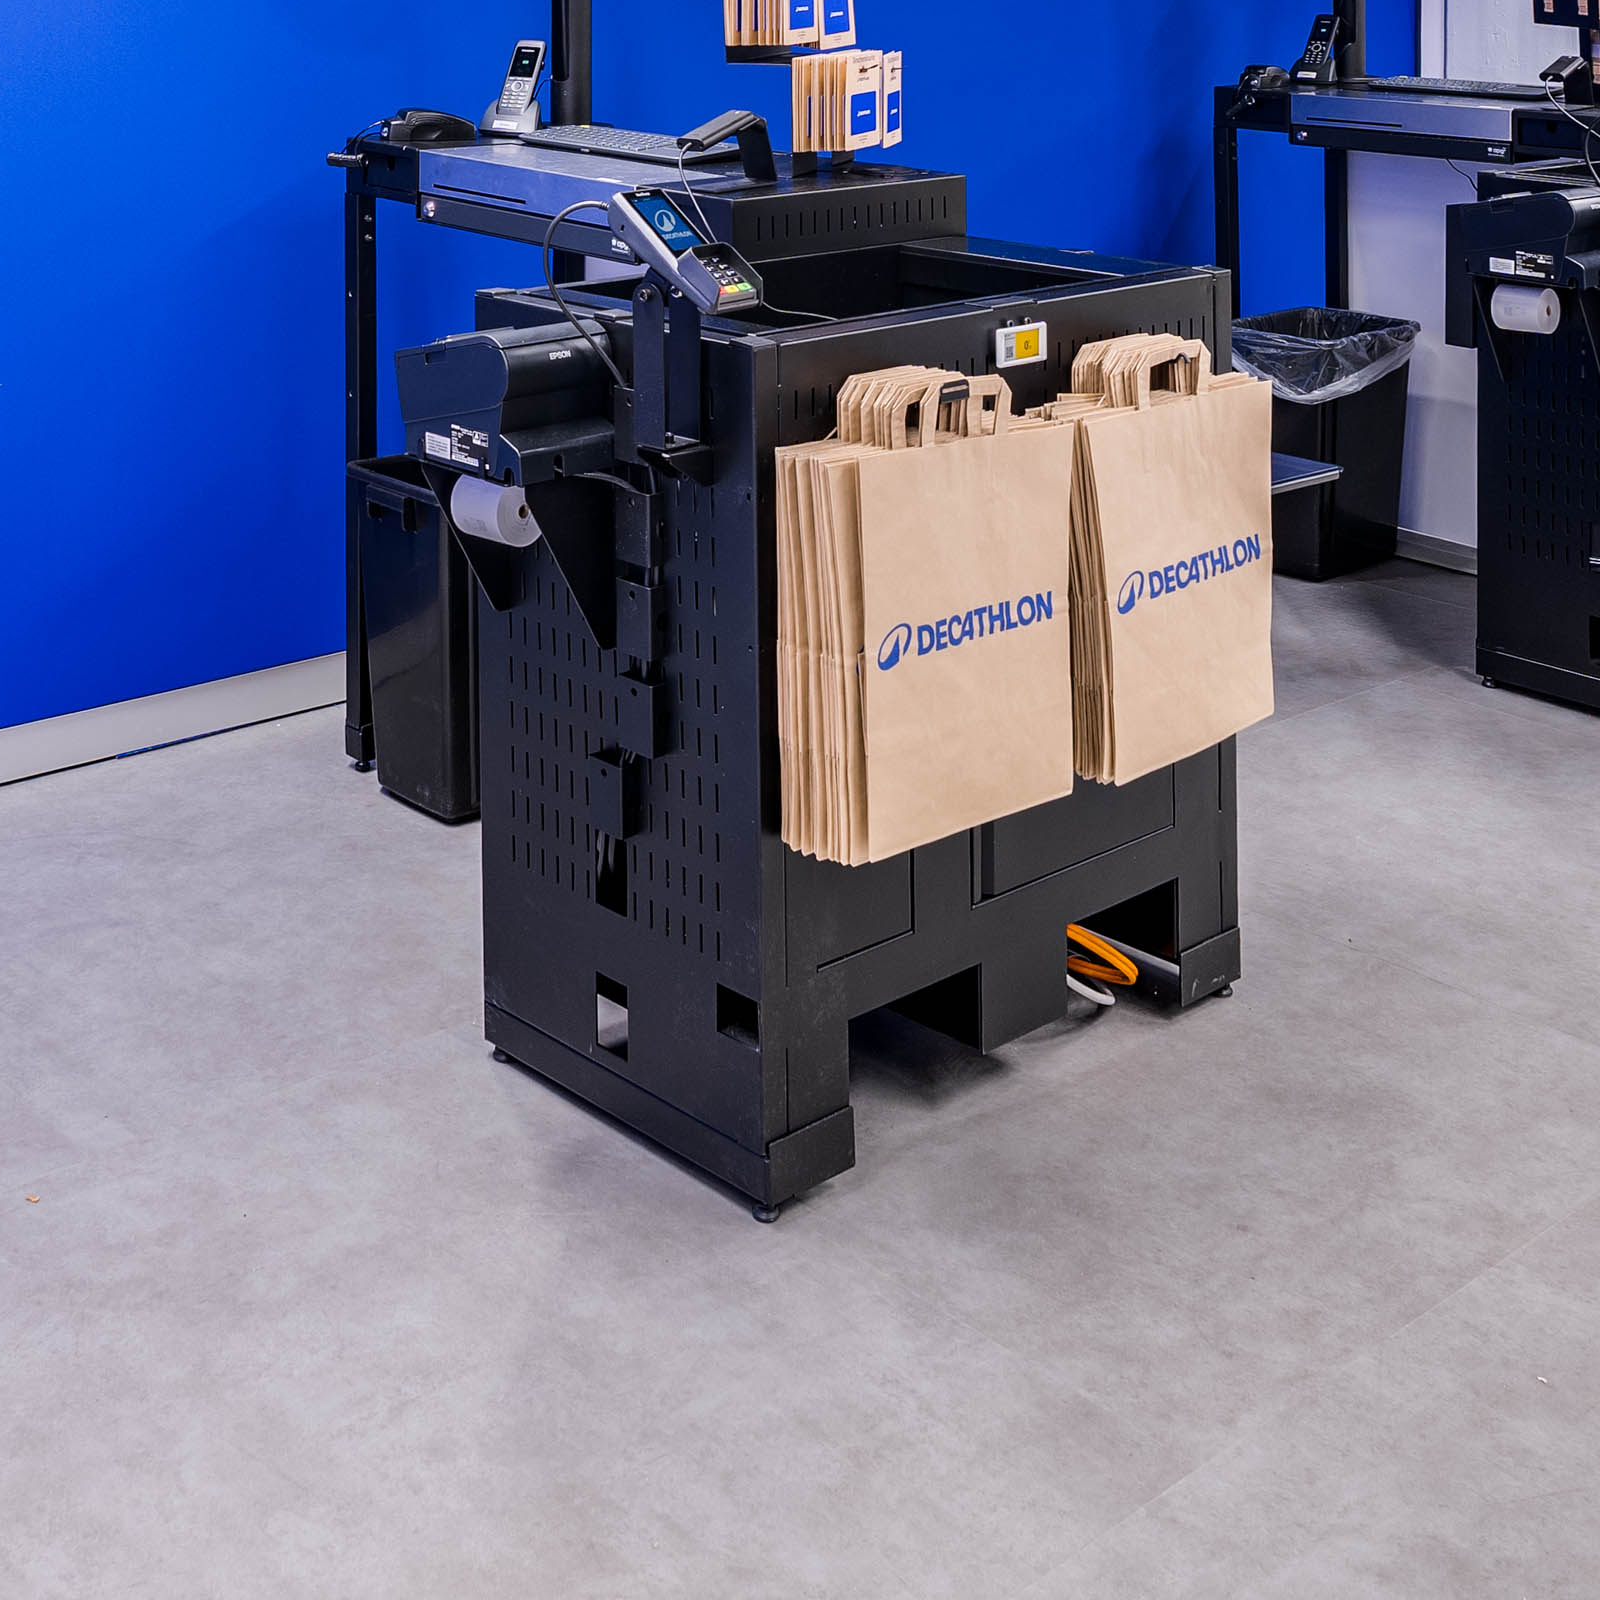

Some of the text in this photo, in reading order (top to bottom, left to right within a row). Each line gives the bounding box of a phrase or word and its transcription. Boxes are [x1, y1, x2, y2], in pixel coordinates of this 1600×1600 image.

[549, 350, 572, 360] EPSON
[1148, 533, 1262, 600] DECATHLON
[916, 590, 1054, 657] DECATHLON
